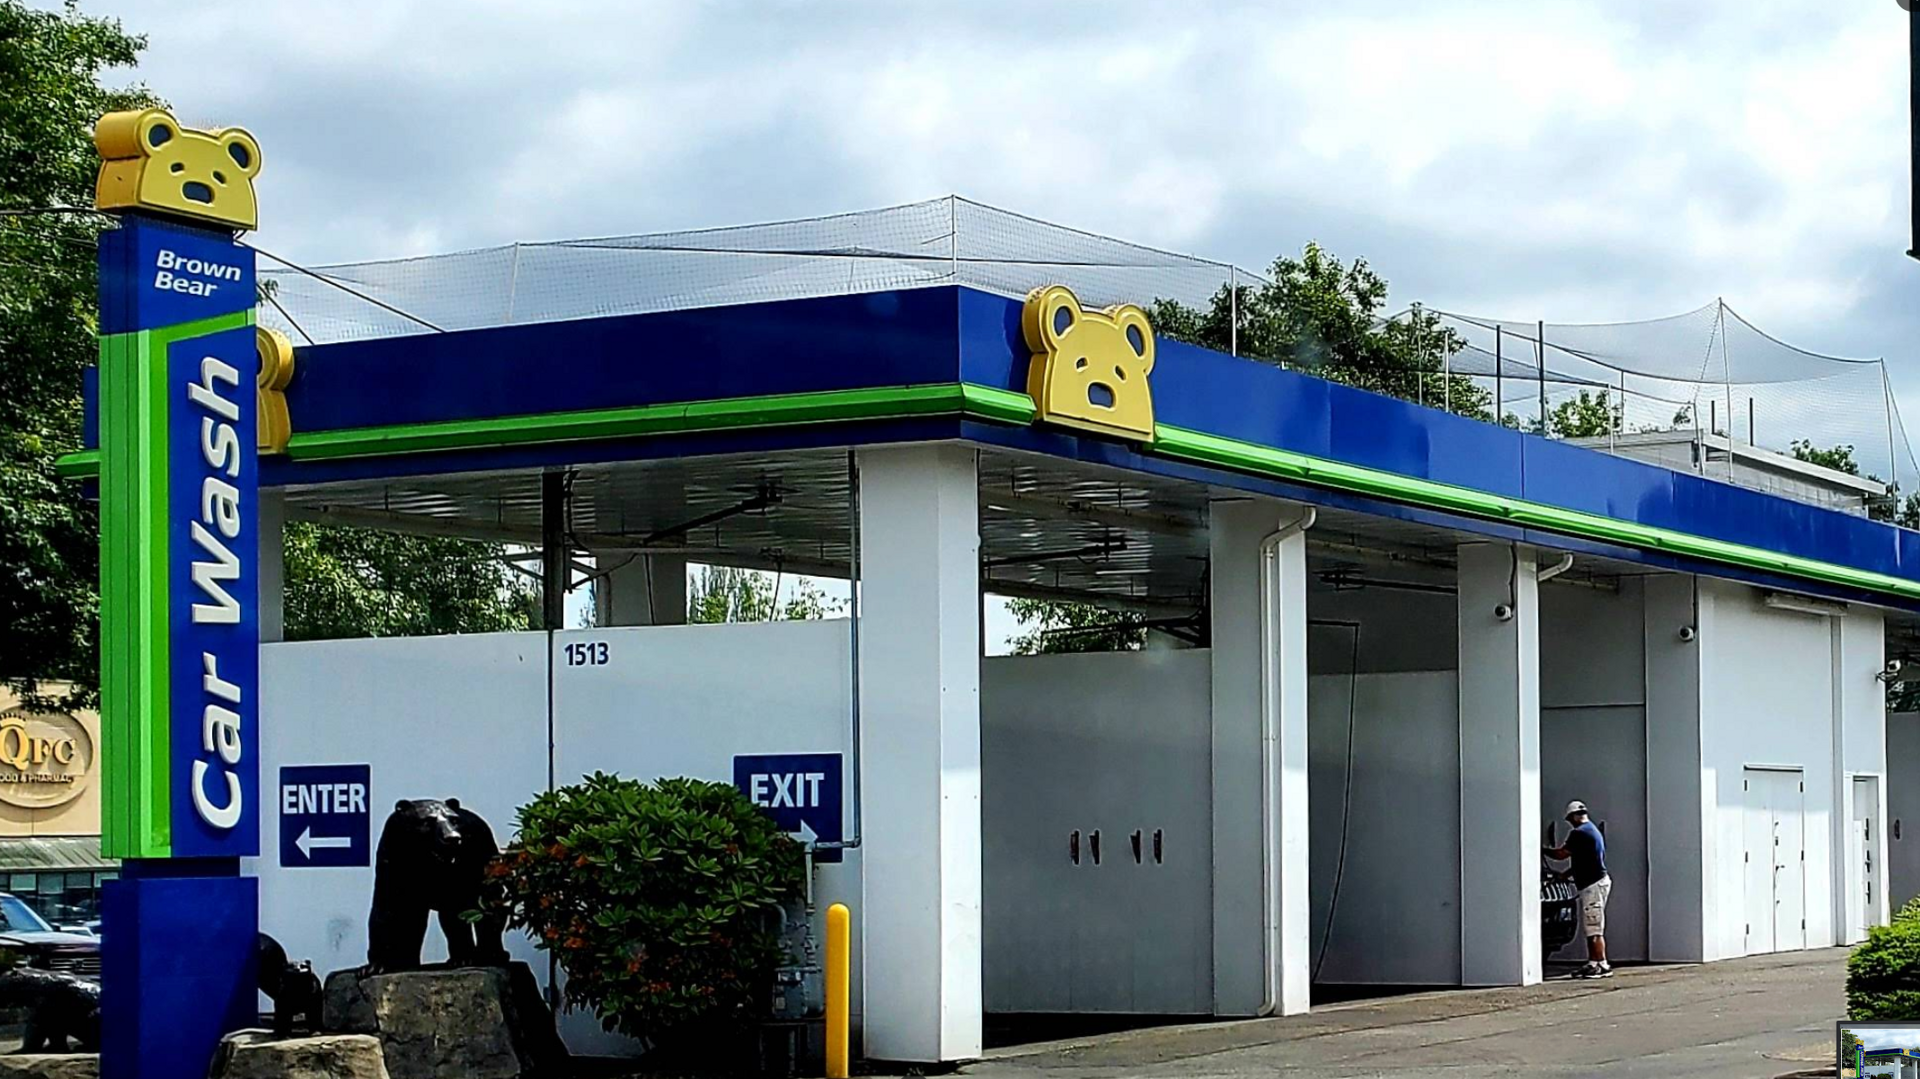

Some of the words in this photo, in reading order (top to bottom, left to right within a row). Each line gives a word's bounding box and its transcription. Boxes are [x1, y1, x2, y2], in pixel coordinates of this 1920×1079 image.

[156, 249, 241, 281] Brown
[154, 270, 218, 297] Bear
[187, 356, 241, 624] Wash
[564, 642, 610, 666] 1513
[0, 725, 77, 772] QFC
[191, 651, 242, 828] Car
[0, 772, 18, 783] OOD
[750, 772, 825, 808] EXIT
[282, 783, 367, 814] ENTER
